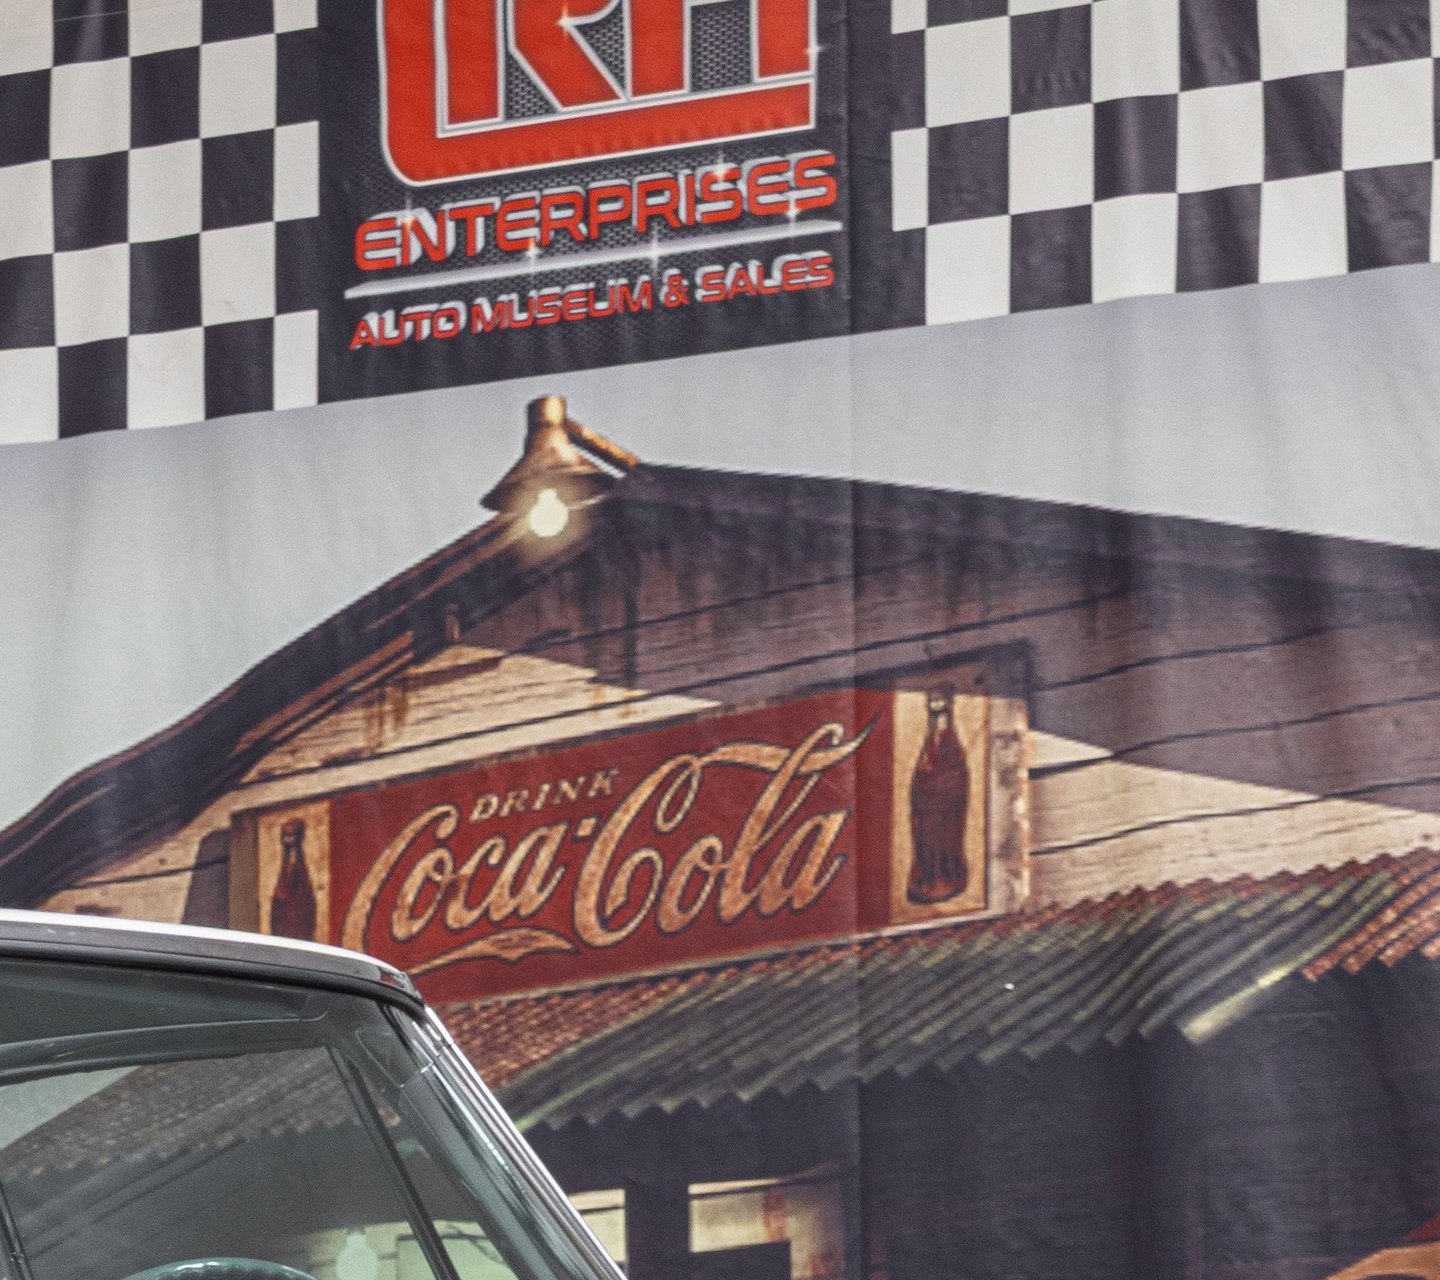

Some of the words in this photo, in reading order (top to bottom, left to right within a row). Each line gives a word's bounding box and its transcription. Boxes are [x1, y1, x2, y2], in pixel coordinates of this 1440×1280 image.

[353, 149, 838, 271] ENTERPRISES
[349, 298, 470, 351] AUTO
[471, 274, 653, 334] MUSEUM
[652, 268, 689, 309] &
[694, 250, 835, 304] SALES
[342, 712, 879, 977] Coca-Cola
[469, 765, 621, 823] DRINK
